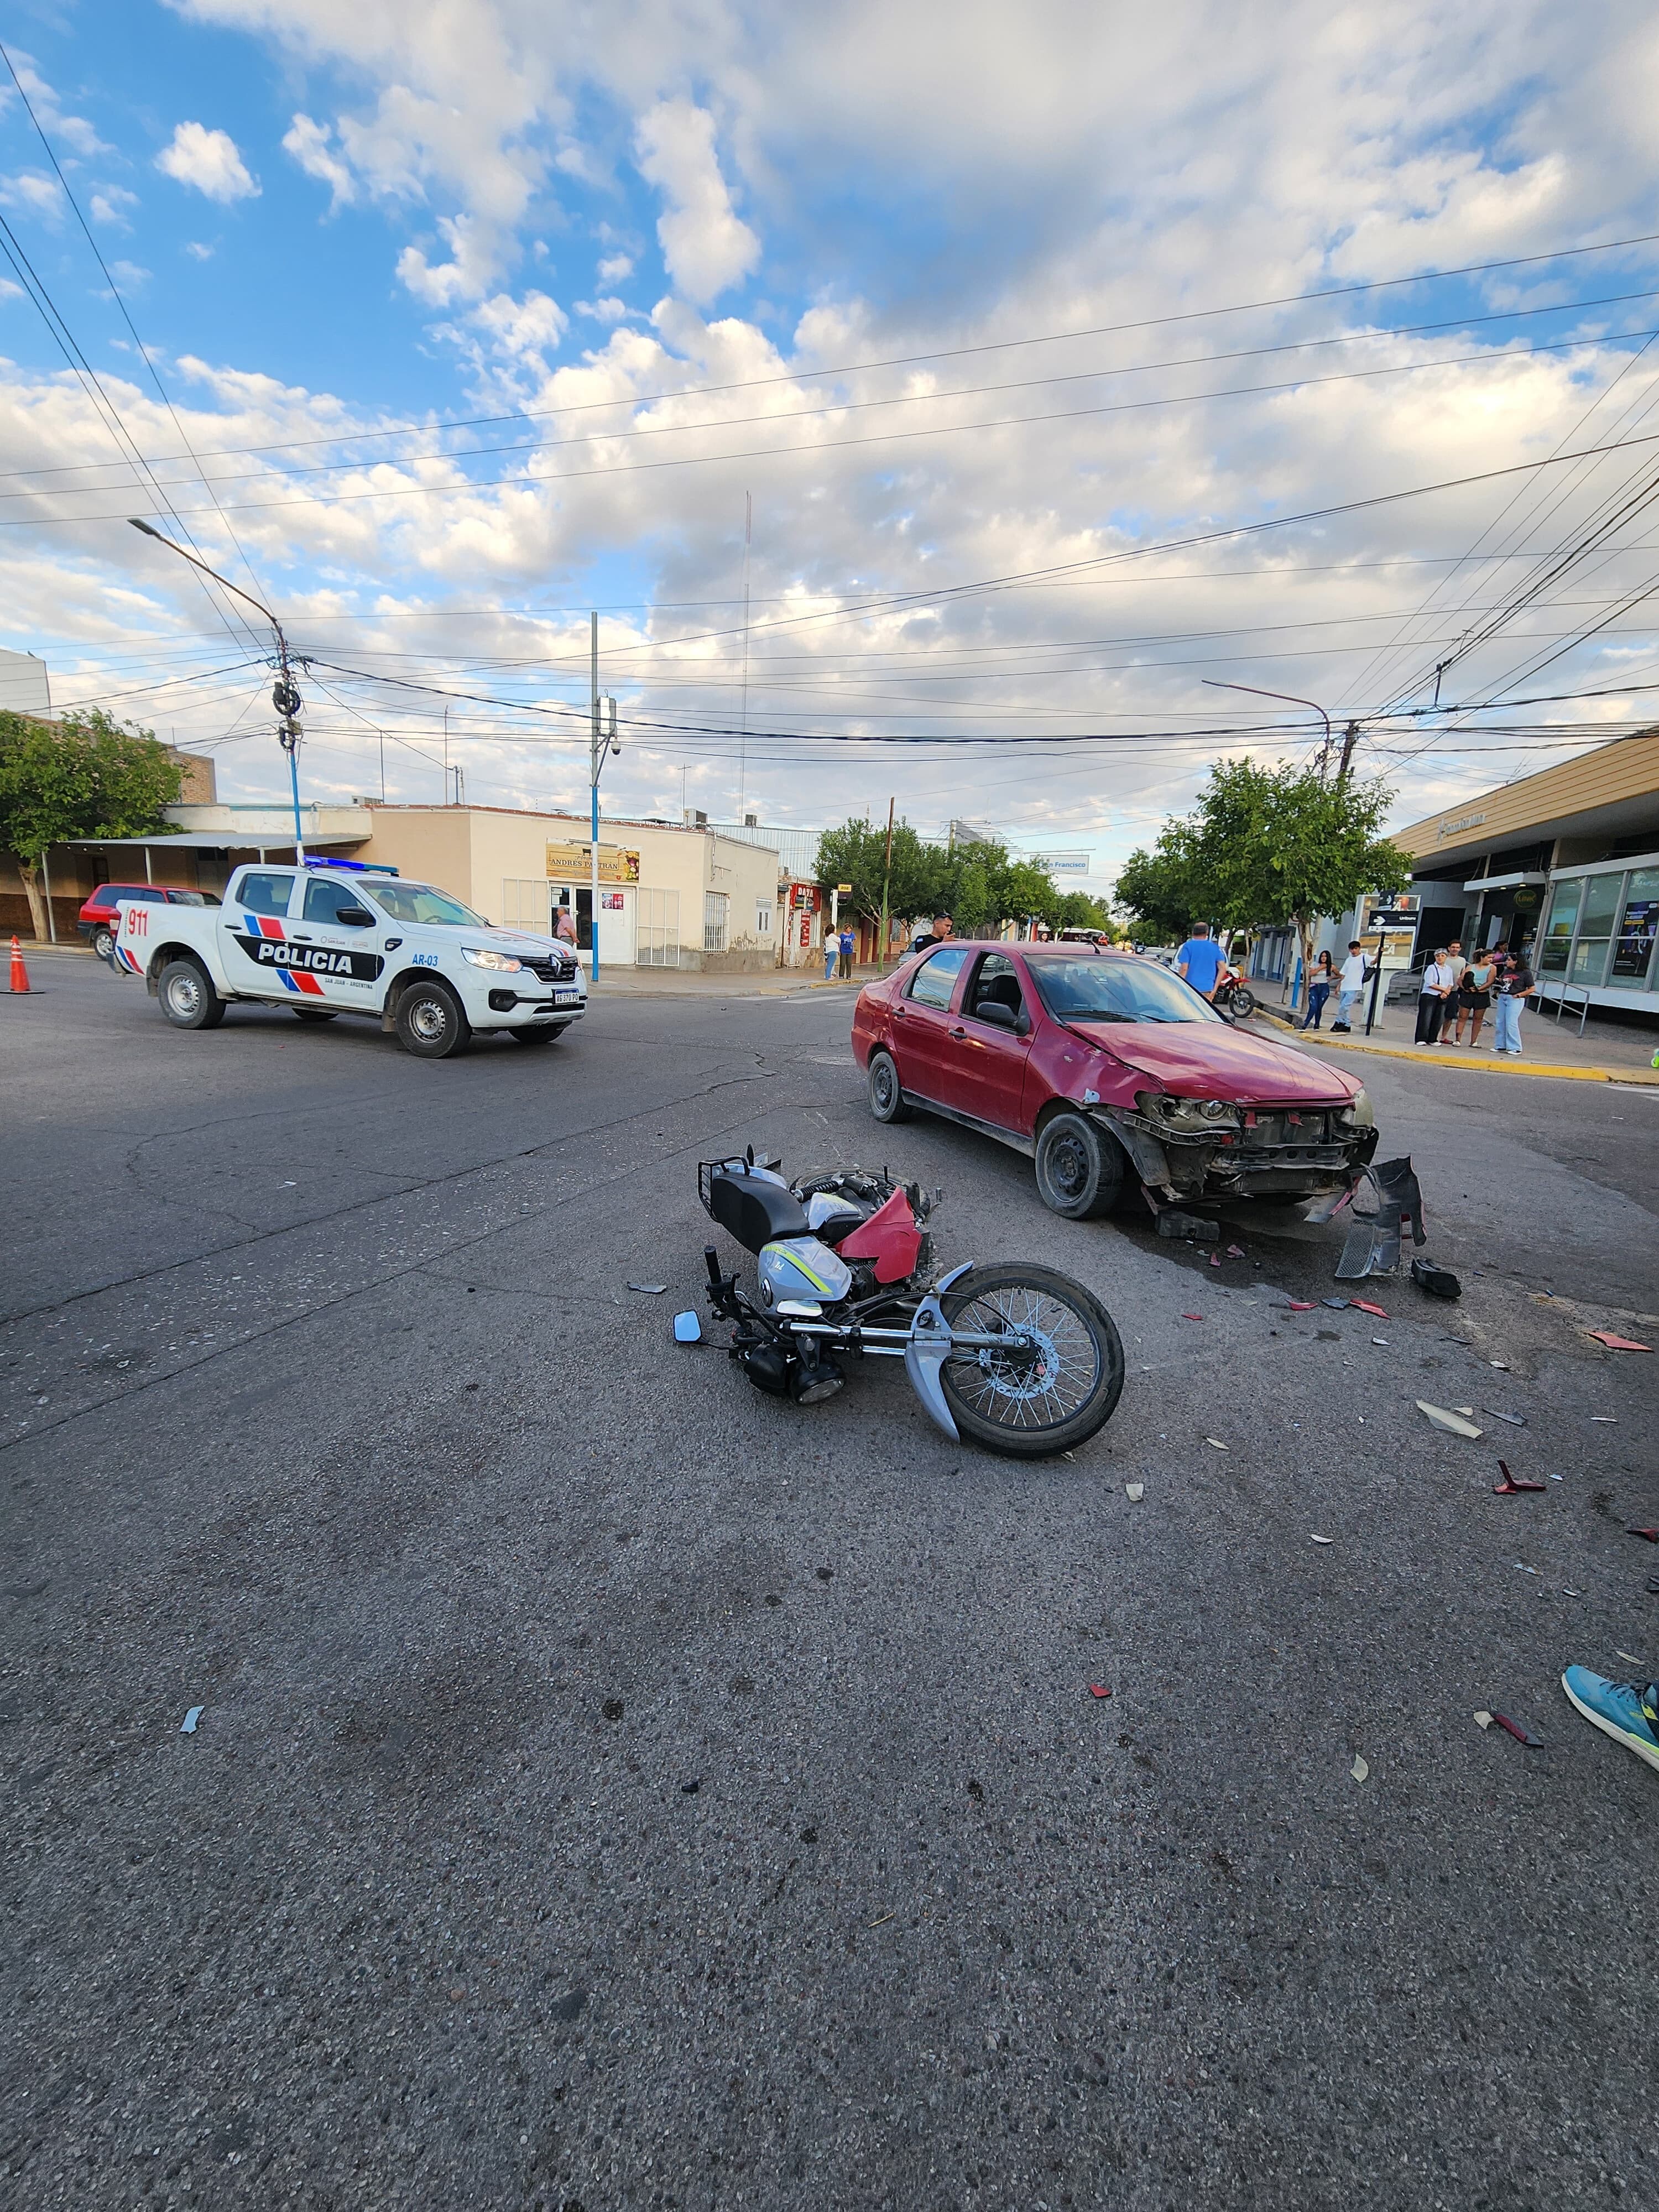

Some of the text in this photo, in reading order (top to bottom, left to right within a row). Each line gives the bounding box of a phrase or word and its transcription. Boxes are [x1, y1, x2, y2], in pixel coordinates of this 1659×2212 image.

[551, 858, 618, 870] ANDRÉS PATRÁN
[798, 887, 813, 898] DAZA
[128, 909, 148, 936] 911
[258, 943, 353, 974] POLICIA
[412, 954, 438, 967] AR-03
[349, 981, 373, 989] ARGENTINA
